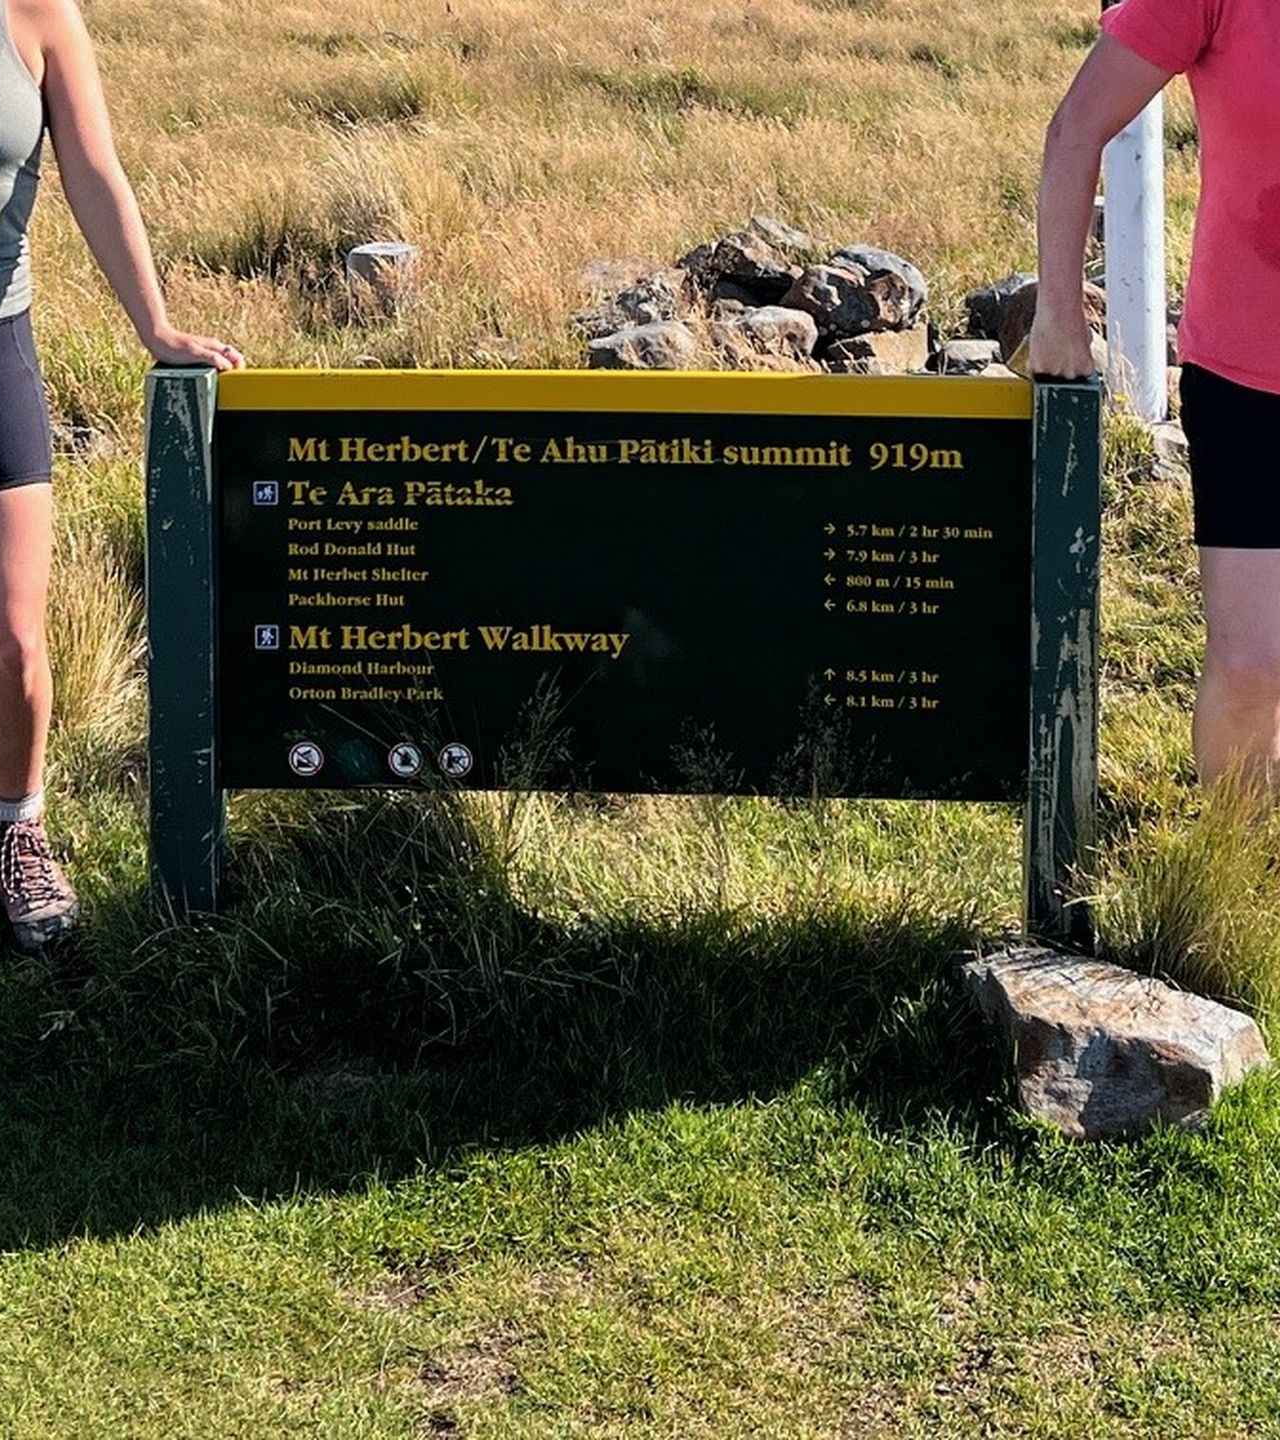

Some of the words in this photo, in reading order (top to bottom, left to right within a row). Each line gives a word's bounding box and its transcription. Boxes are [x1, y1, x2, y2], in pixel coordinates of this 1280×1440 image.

[287, 437, 331, 462] Mt
[540, 436, 608, 463] Ahu
[618, 437, 715, 464] Pātiki
[723, 440, 852, 467] summit
[869, 442, 964, 472] 919m
[287, 480, 328, 506] Te
[336, 481, 396, 506] Ara
[404, 479, 513, 506] Pātaka
[288, 518, 321, 531] Port
[326, 518, 363, 534] Levy
[367, 517, 418, 531] saddle
[847, 524, 868, 537] 5.7
[871, 524, 895, 537] km
[910, 525, 918, 537] 2
[922, 525, 940, 538] hr
[942, 526, 960, 539] 30
[964, 527, 993, 539] min
[288, 542, 319, 556] Rod
[324, 542, 382, 556] Donald
[386, 543, 415, 556] Hut
[846, 549, 868, 563] 7.9
[871, 549, 895, 562] km
[910, 551, 918, 564] 3
[922, 550, 939, 563] hr
[288, 568, 309, 581] Mt
[371, 567, 429, 581] Shelter
[846, 575, 872, 587] 800
[875, 578, 890, 587] m
[906, 576, 921, 589] 15
[925, 576, 954, 589] min
[288, 592, 371, 606] Packhorse
[376, 593, 404, 606] Hut
[846, 599, 868, 612] 6.8
[871, 600, 895, 613] km
[909, 601, 918, 614] 3
[922, 601, 939, 614] hr
[288, 625, 332, 650] Mt
[340, 623, 470, 650] Herbert
[477, 624, 630, 659] Walkway
[289, 661, 363, 675] Diamond
[367, 661, 435, 675] Harbour
[846, 670, 868, 682] 8.5
[871, 670, 894, 682] km
[909, 671, 918, 684] 3
[921, 671, 939, 683] hr
[289, 687, 336, 700] Orton
[341, 686, 402, 703] Bradley
[407, 687, 444, 700] Park
[846, 696, 866, 707] 8.1
[871, 695, 894, 708] km
[909, 696, 918, 710] 3
[921, 696, 939, 709] hr
